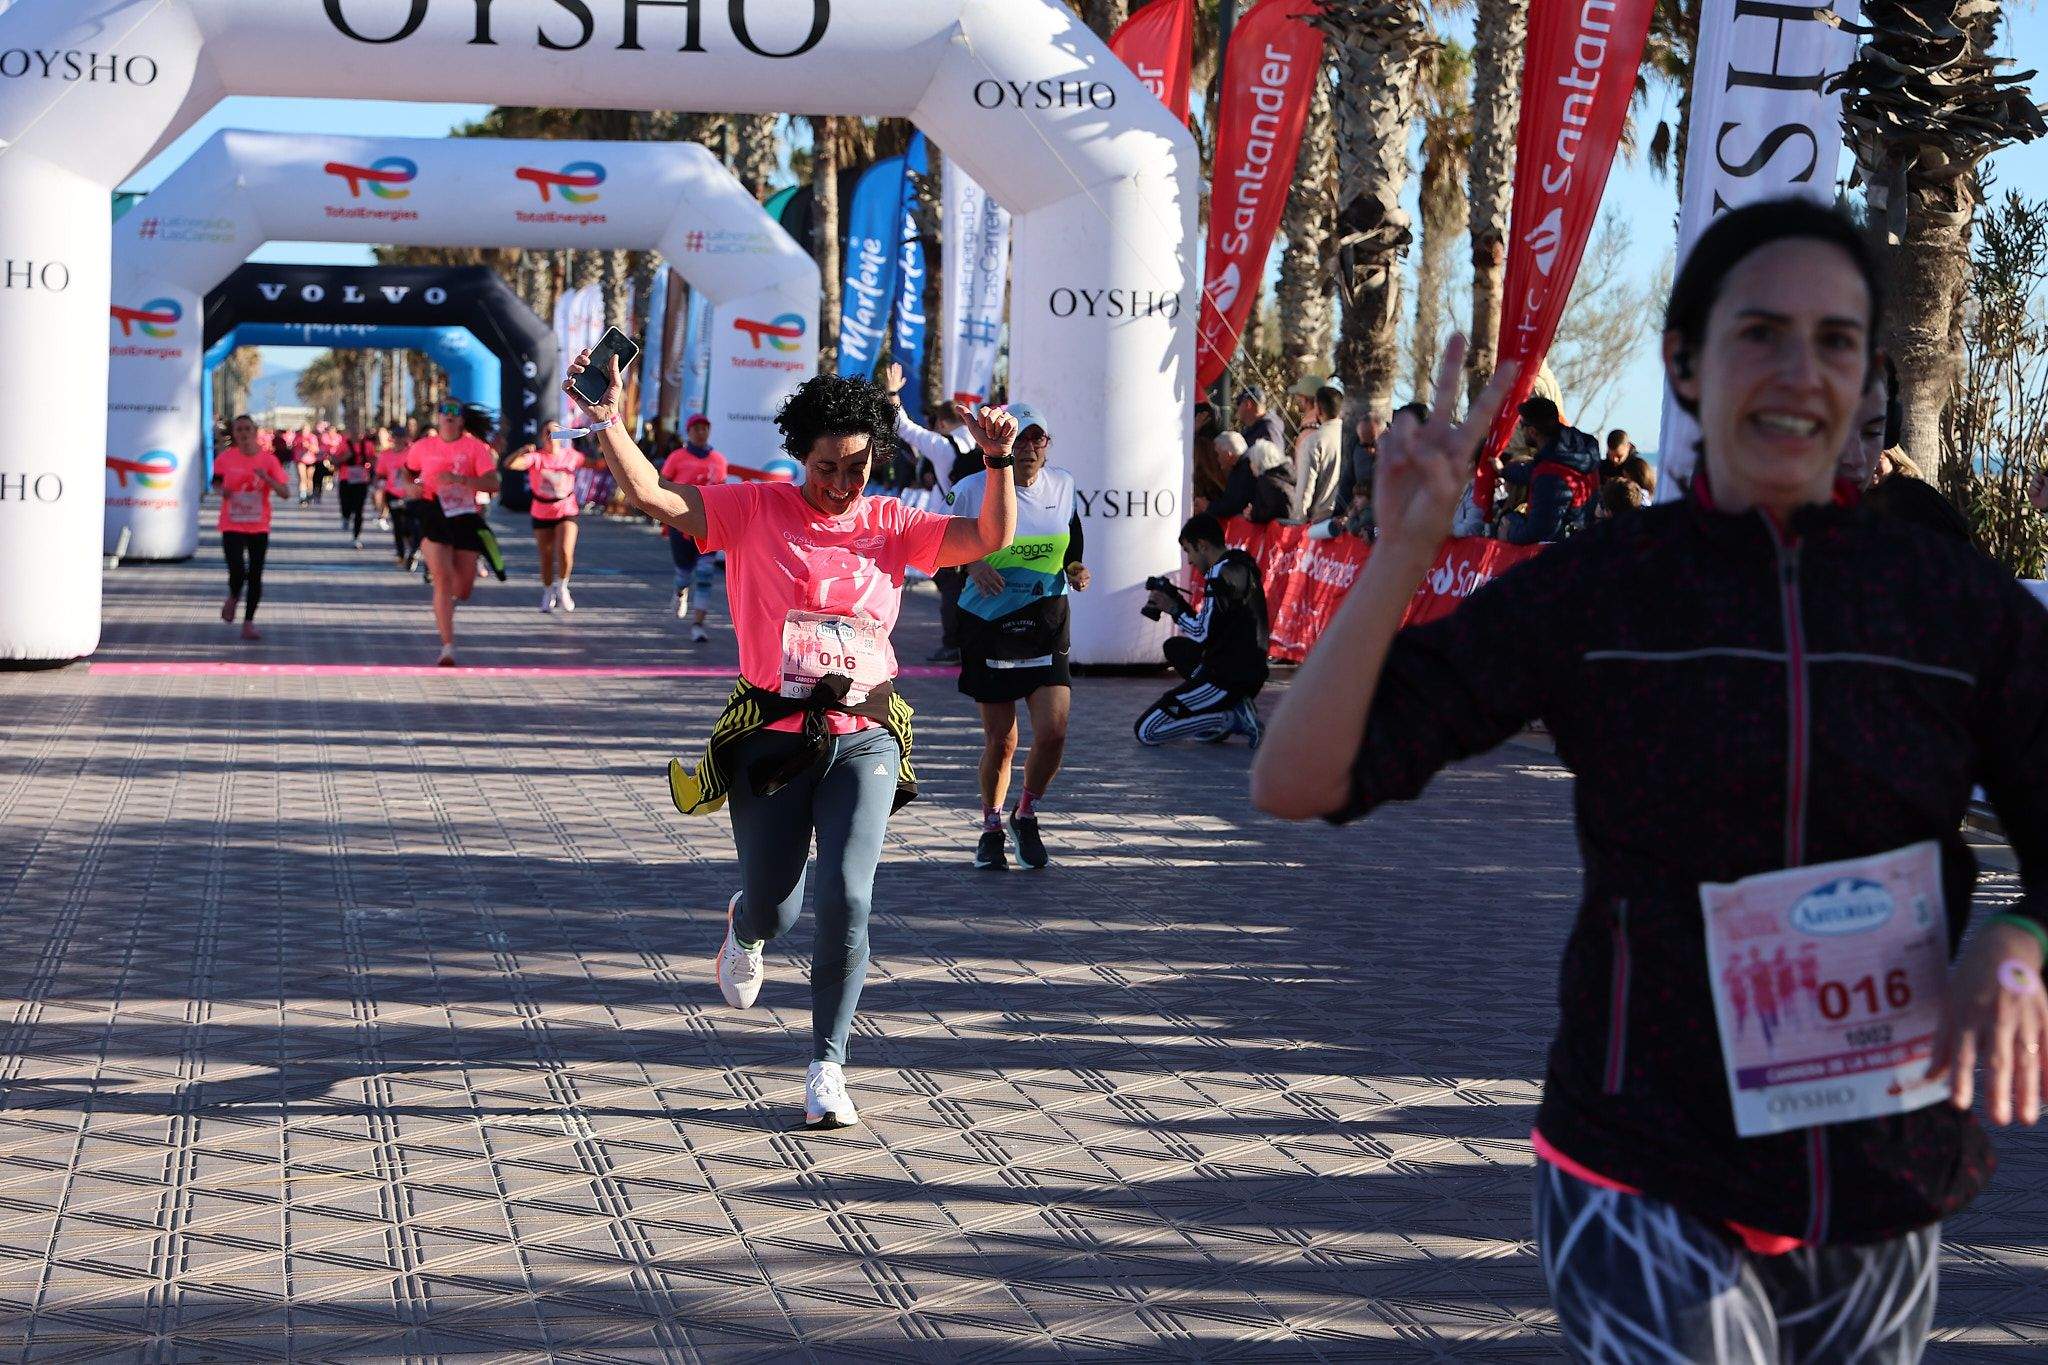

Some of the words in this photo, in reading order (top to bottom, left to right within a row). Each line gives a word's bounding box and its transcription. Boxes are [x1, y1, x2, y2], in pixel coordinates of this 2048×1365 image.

[0, 48, 158, 87] OYSHO
[974, 79, 1116, 110] OYSHO
[1222, 43, 1292, 256] Santander
[325, 206, 418, 222] TotalEnergies
[516, 210, 607, 226] TotalEnergies
[257, 283, 448, 305] VOLVO
[841, 237, 886, 361] Marlene
[1050, 288, 1180, 318] OYSHO
[1076, 489, 1175, 518] YSHO
[1010, 542, 1054, 557] saggas
[819, 652, 856, 670] 016
[1817, 969, 1912, 1021] 016
